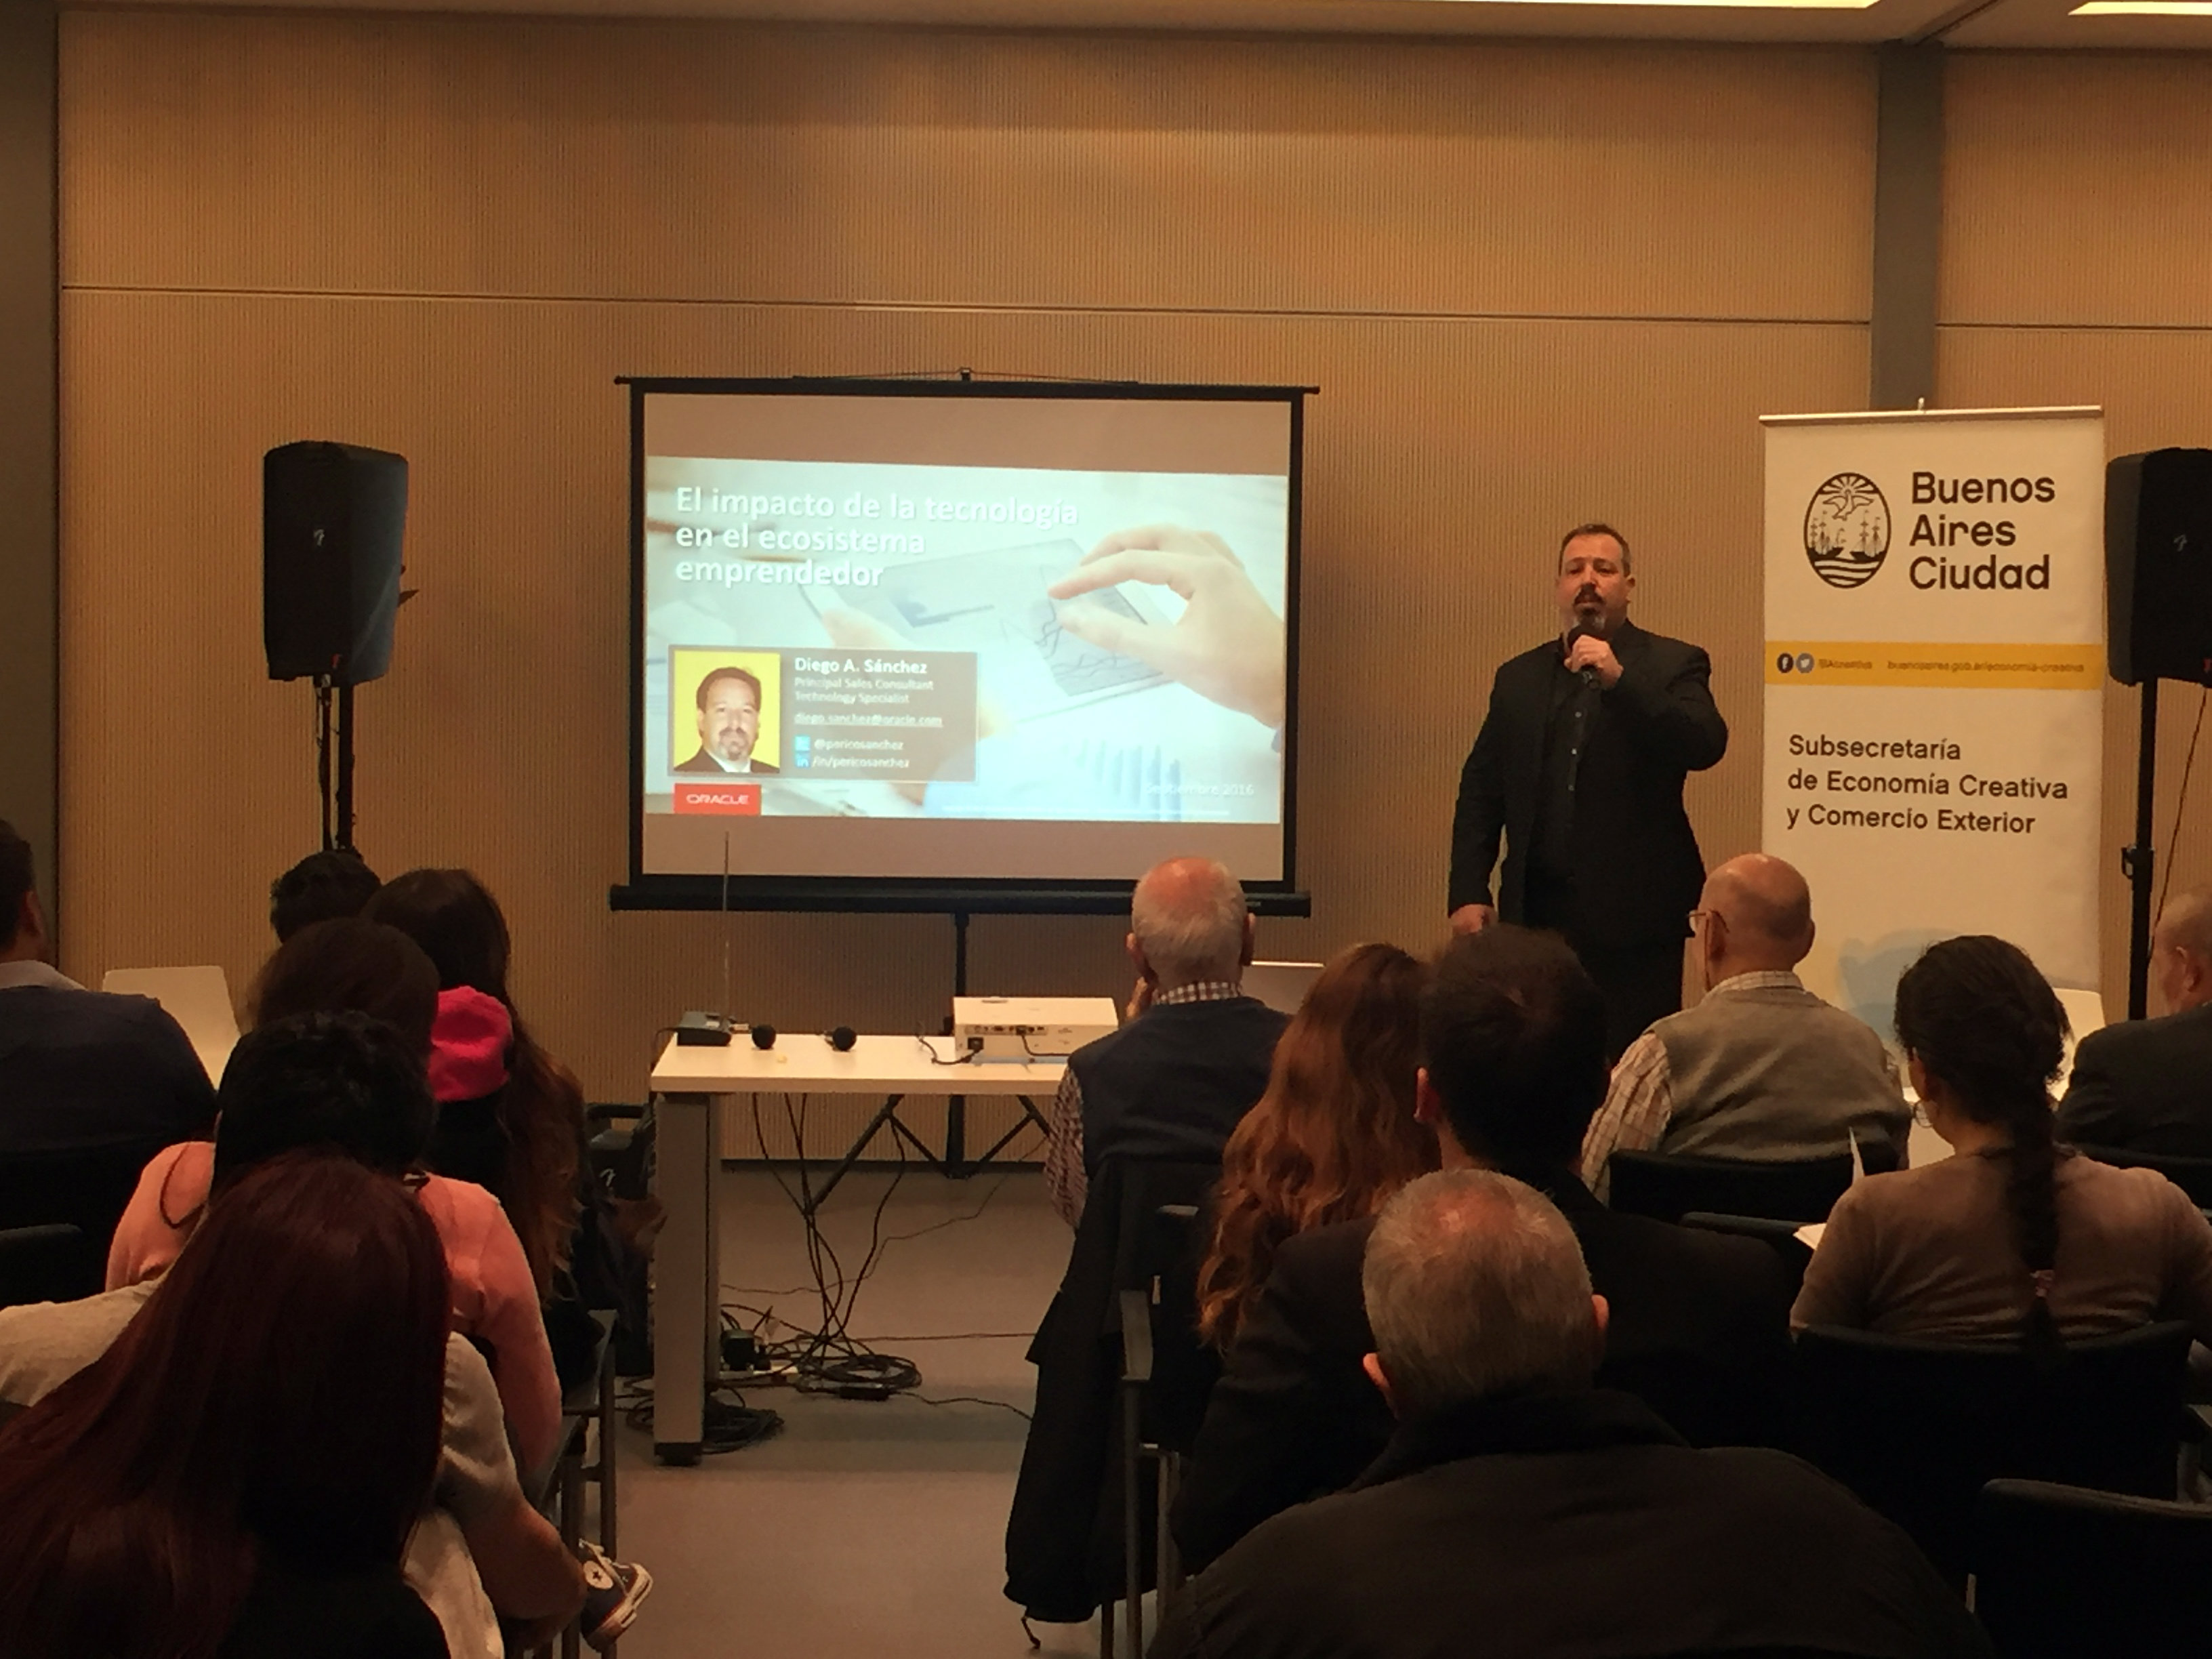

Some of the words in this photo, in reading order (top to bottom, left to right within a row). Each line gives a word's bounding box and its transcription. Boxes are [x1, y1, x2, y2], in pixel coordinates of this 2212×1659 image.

[1912, 472, 2055, 504] Buenos
[677, 486, 701, 512] El
[712, 488, 835, 520] impacto
[844, 491, 881, 518] de
[890, 493, 916, 520] la
[925, 496, 1078, 531] tecnología
[676, 527, 713, 548] en
[722, 523, 749, 548] el
[759, 526, 926, 554] ecosistema
[1909, 514, 2016, 546] Aires
[676, 558, 883, 588] emprendedor
[1909, 554, 2050, 590] Ciudad
[794, 657, 840, 674] Diego
[843, 658, 860, 672] A.
[863, 658, 928, 674] Sánchez
[794, 676, 842, 690] Principal
[844, 678, 873, 689] Sales
[875, 678, 934, 691] Consultant
[795, 691, 857, 704] Technology
[859, 693, 910, 705] Specialist
[1788, 734, 1961, 760] Subsecretaría
[1222, 783, 1254, 796] 2016
[1787, 768, 1818, 791] de
[1826, 770, 1950, 795] Economía
[1959, 774, 2069, 799] Creativa
[686, 794, 750, 805] ORACLE
[1786, 807, 1800, 830] y
[1807, 804, 1929, 829] Comercio
[1937, 809, 2036, 834] Exterior
